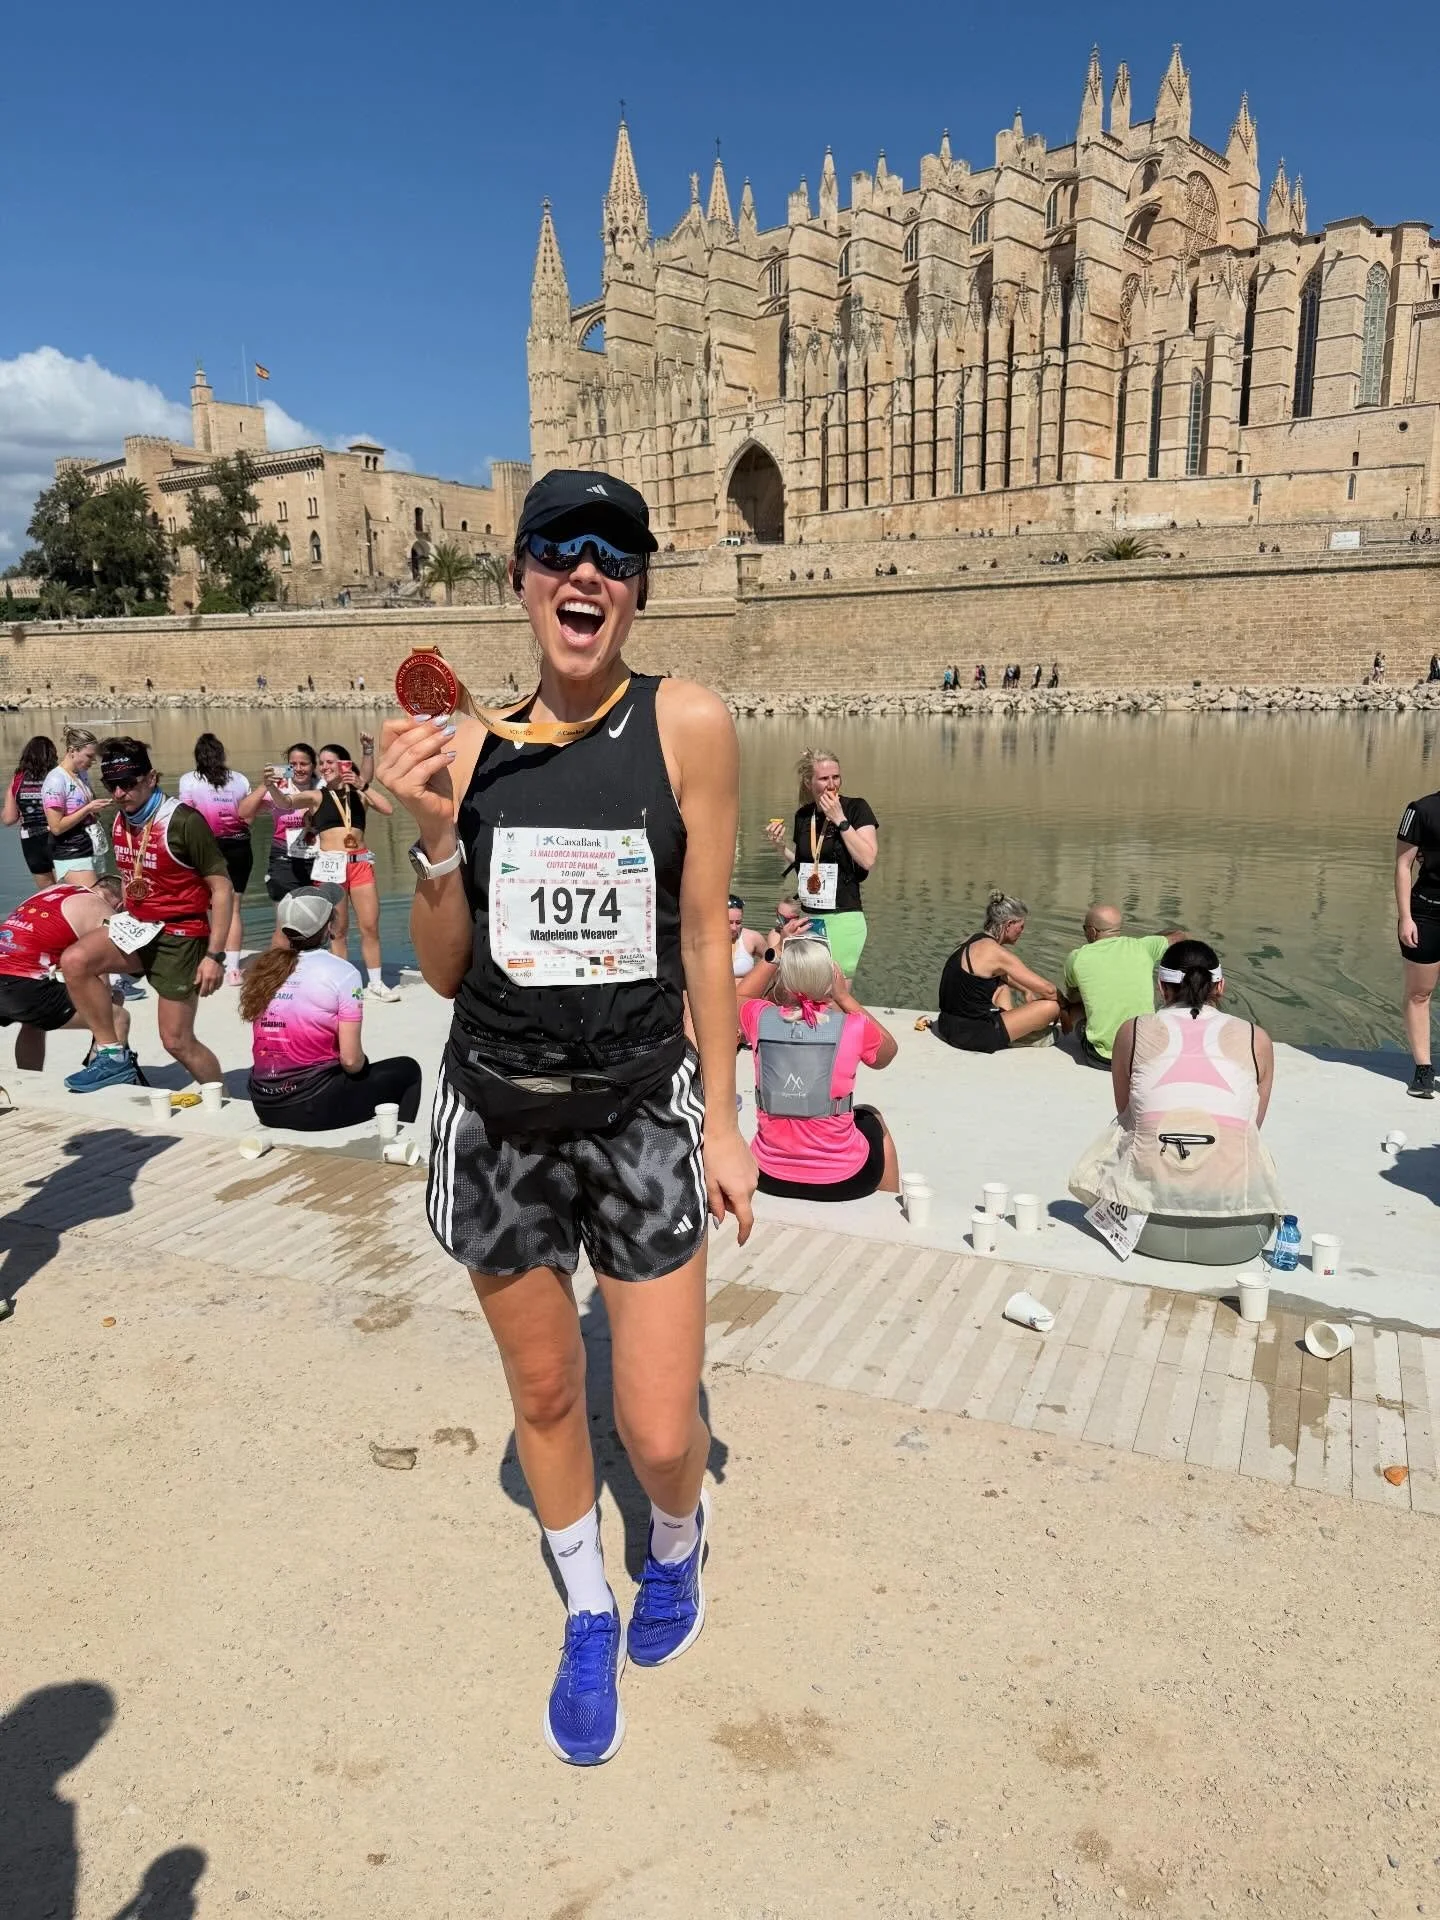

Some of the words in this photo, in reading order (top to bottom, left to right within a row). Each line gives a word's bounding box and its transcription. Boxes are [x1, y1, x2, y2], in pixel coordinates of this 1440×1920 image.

[556, 835, 602, 848] CaixaBank
[537, 850, 570, 858] MALLORCA
[321, 861, 339, 871] 1871
[546, 861, 568, 869] CIUTAT
[577, 862, 598, 870] PALMA
[530, 886, 622, 925] 1974
[530, 929, 579, 941] Madeleine
[580, 928, 618, 940] Weaver
